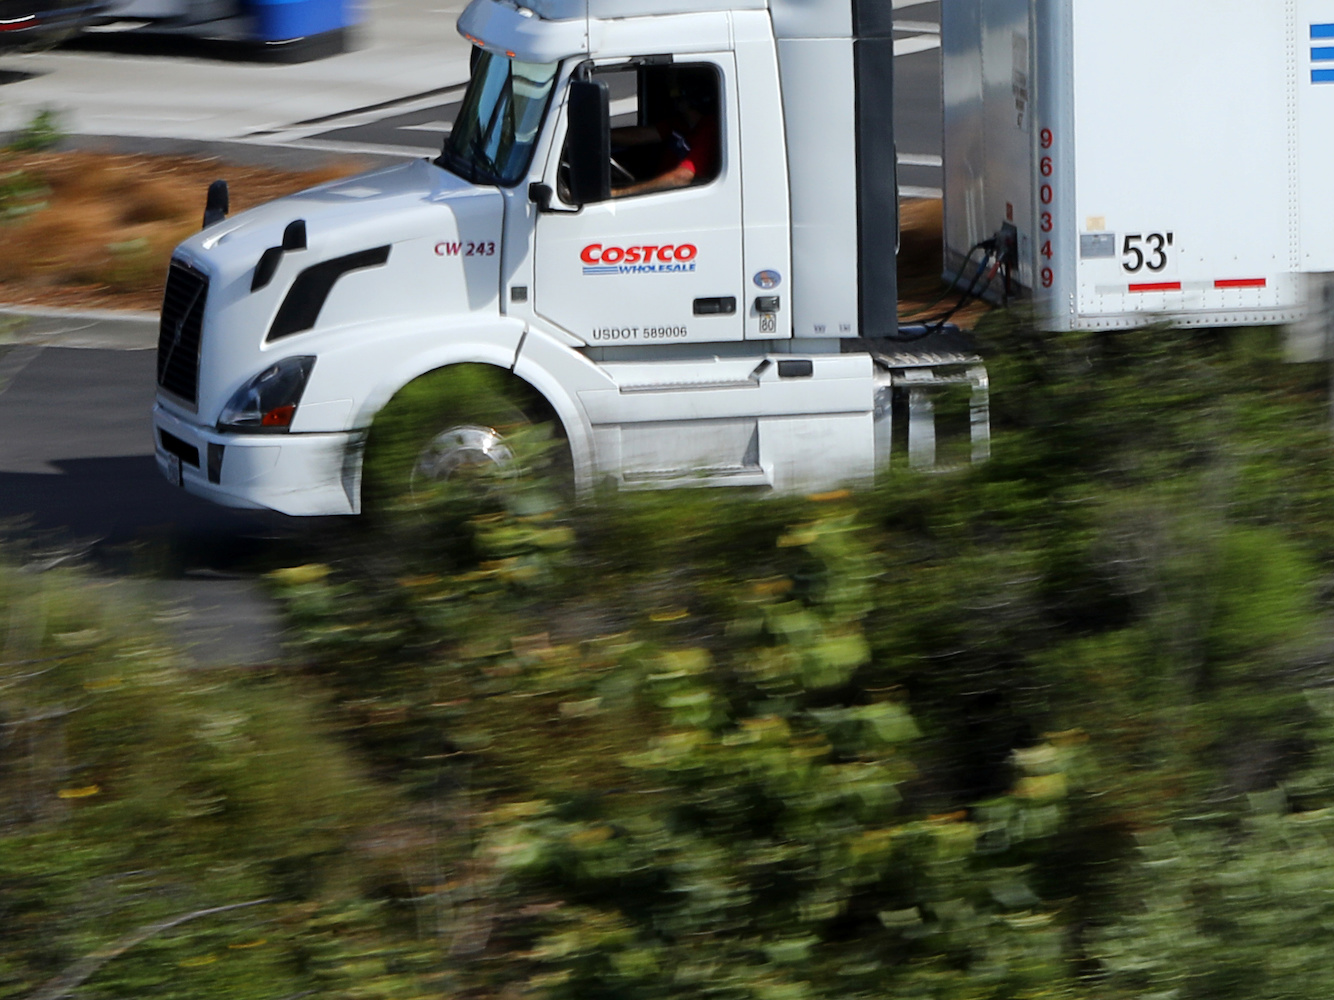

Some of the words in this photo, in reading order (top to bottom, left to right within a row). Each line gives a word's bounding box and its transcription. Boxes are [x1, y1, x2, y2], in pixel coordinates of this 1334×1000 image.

[1040, 128, 1054, 288] 960349
[434, 242, 462, 257] CW
[465, 242, 496, 257] 243
[580, 243, 698, 265] COSTCO
[618, 263, 697, 275] WHOLESALE
[592, 327, 639, 340] USDOT
[643, 326, 688, 339] 589006
